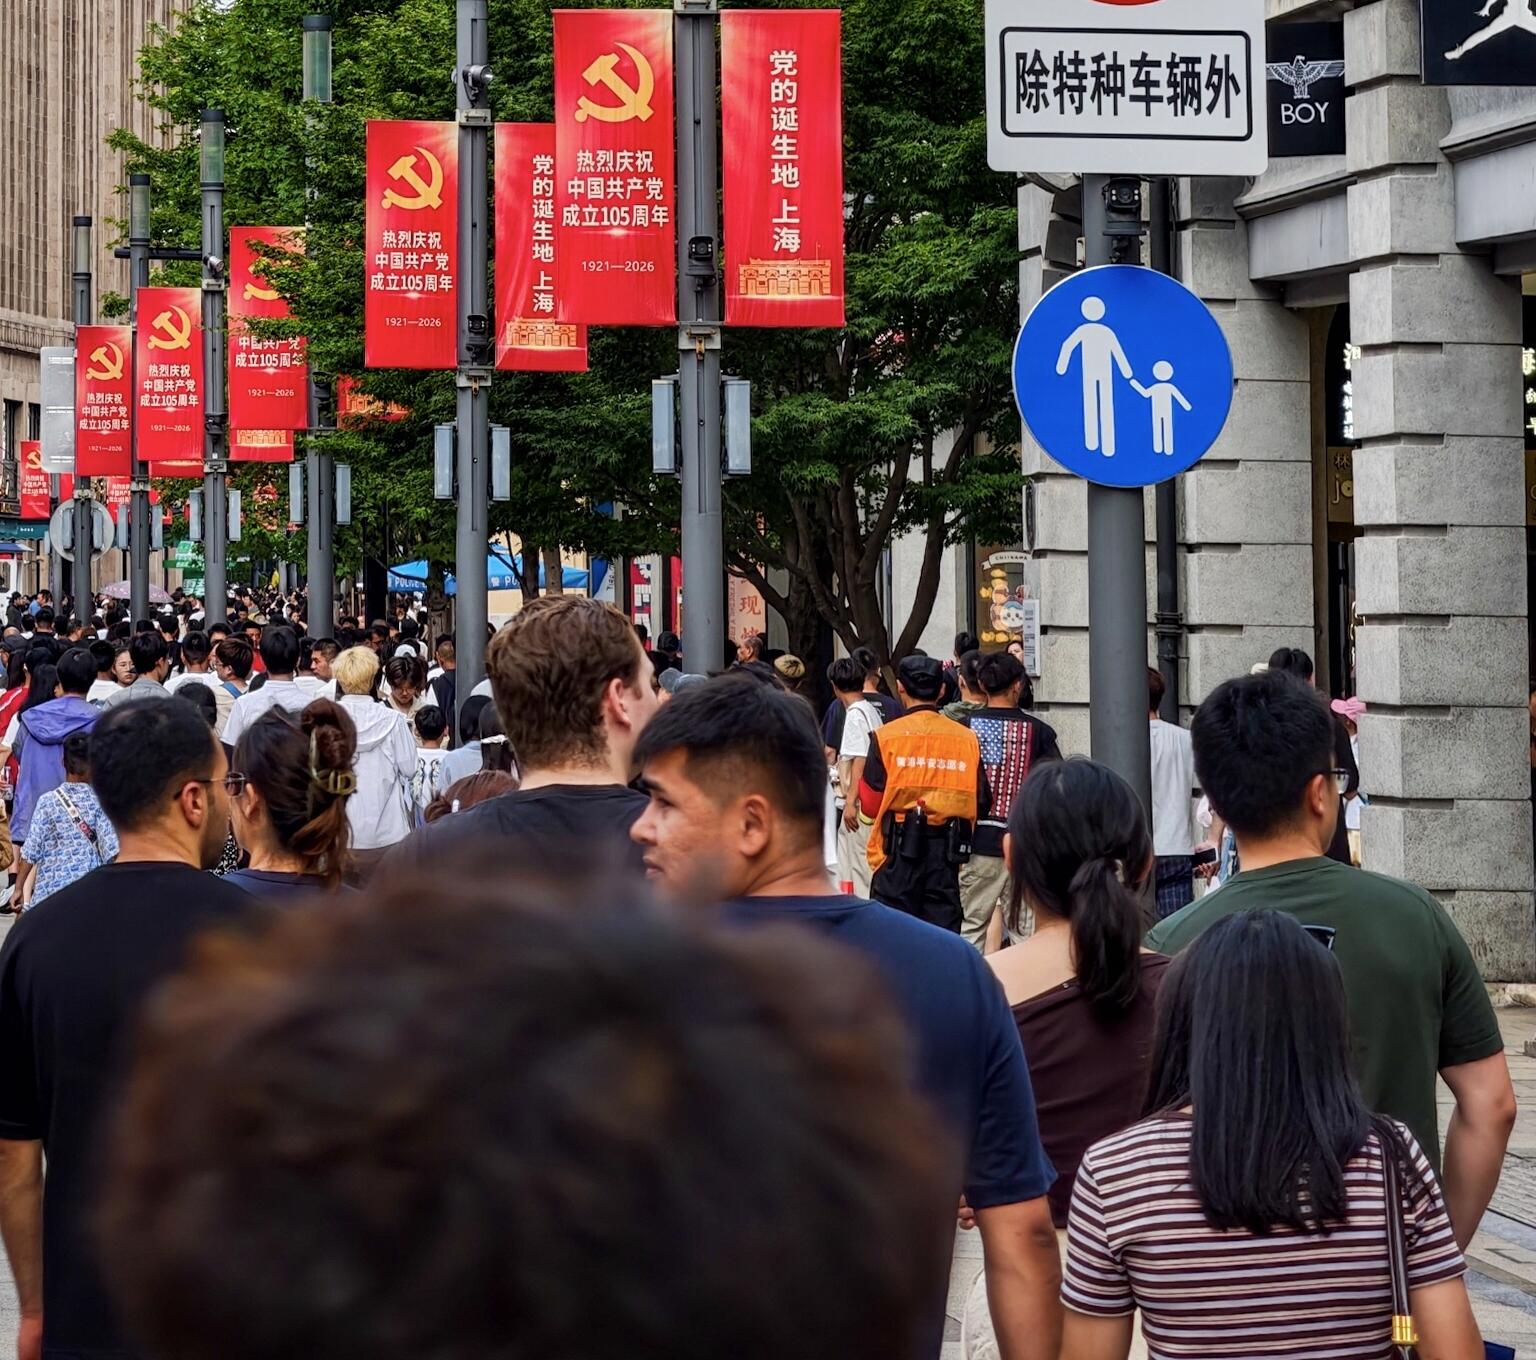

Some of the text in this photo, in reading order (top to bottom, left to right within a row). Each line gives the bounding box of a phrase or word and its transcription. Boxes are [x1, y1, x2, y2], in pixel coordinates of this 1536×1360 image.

[1014, 49, 1240, 119] 除特种车辆外
[1280, 100, 1328, 127] BOY
[576, 149, 654, 174] 热烈庆祝
[769, 49, 802, 254] 党的诞生地 上海
[567, 177, 664, 201] 中国共产党
[561, 204, 670, 229] 成立105周年
[382, 230, 443, 250] 热烈庆祝
[532, 154, 555, 313] 党的诞生地 上海
[374, 252, 450, 272] 中国共产党
[370, 272, 454, 293] 成立105周年
[148, 364, 191, 378] 热烈庆祝
[143, 379, 196, 393] 中国共产党
[86, 393, 123, 405] 热烈庆祝
[140, 394, 199, 408] 成立105周年
[82, 406, 128, 418] 中国共产党
[79, 418, 130, 430] 成立105周年
